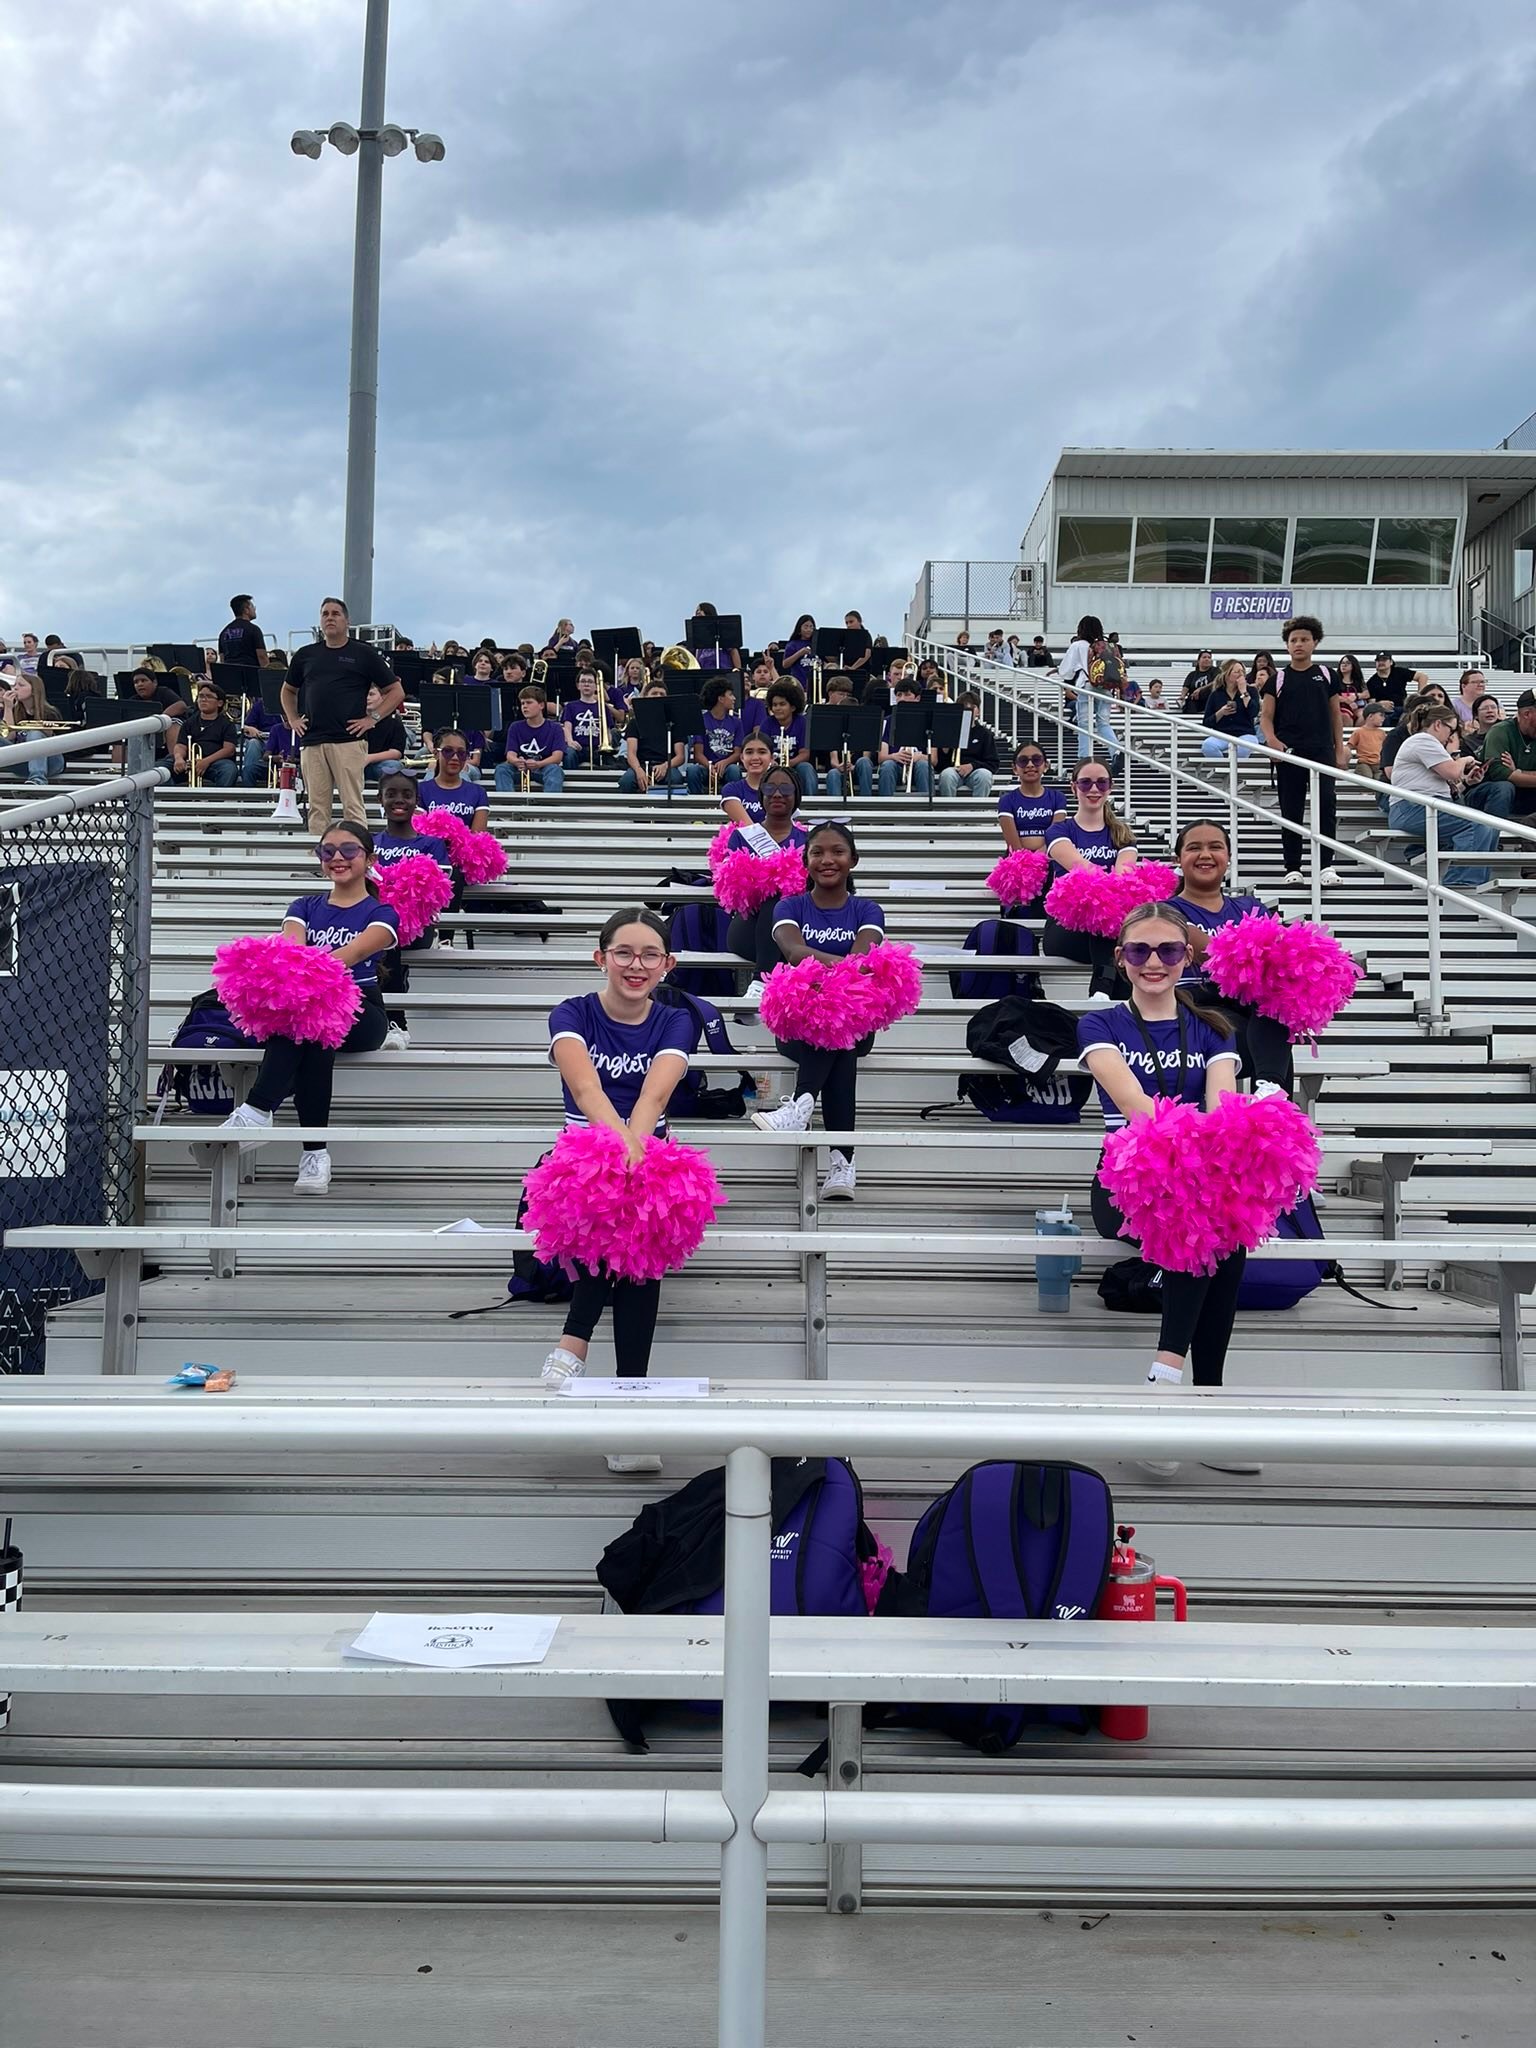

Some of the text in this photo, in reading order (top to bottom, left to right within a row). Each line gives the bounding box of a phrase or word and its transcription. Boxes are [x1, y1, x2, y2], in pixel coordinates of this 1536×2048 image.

[1213, 596, 1291, 614] B RESERVED
[1016, 806, 1053, 820] Angleton
[801, 923, 856, 944] Angleton
[686, 1638, 710, 1646] 16
[1323, 1648, 1353, 1656] 18
